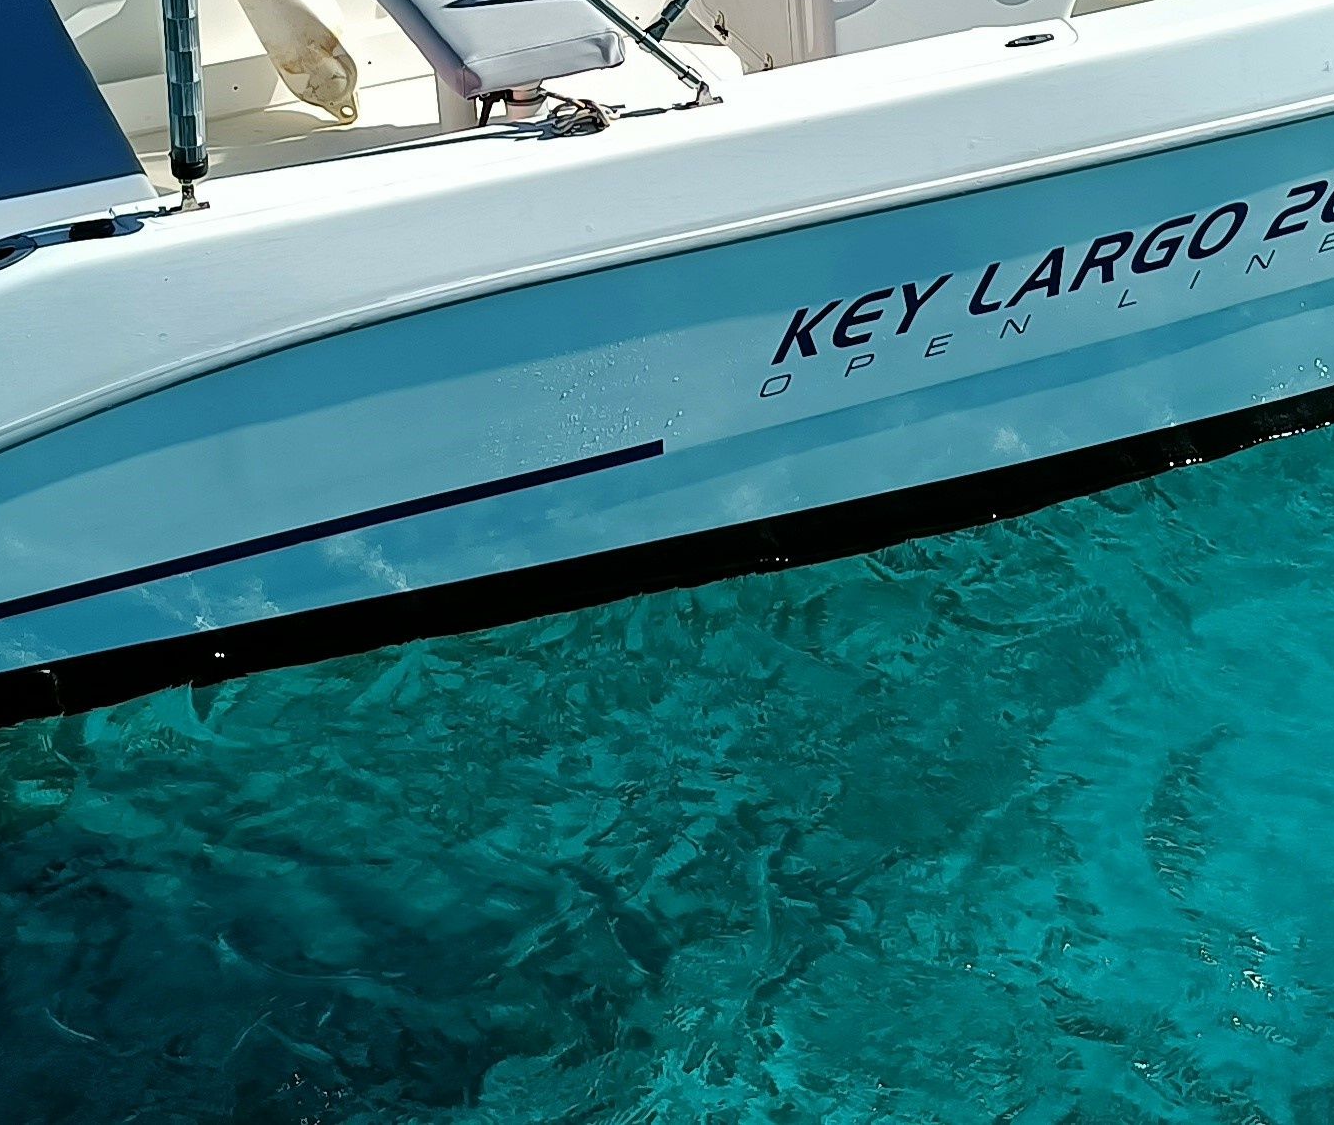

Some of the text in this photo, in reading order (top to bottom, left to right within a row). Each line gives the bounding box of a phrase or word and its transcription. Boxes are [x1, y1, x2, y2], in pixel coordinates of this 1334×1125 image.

[771, 272, 954, 365] KEY
[968, 202, 1248, 315] LARGO
[760, 314, 1031, 397] OPEN
